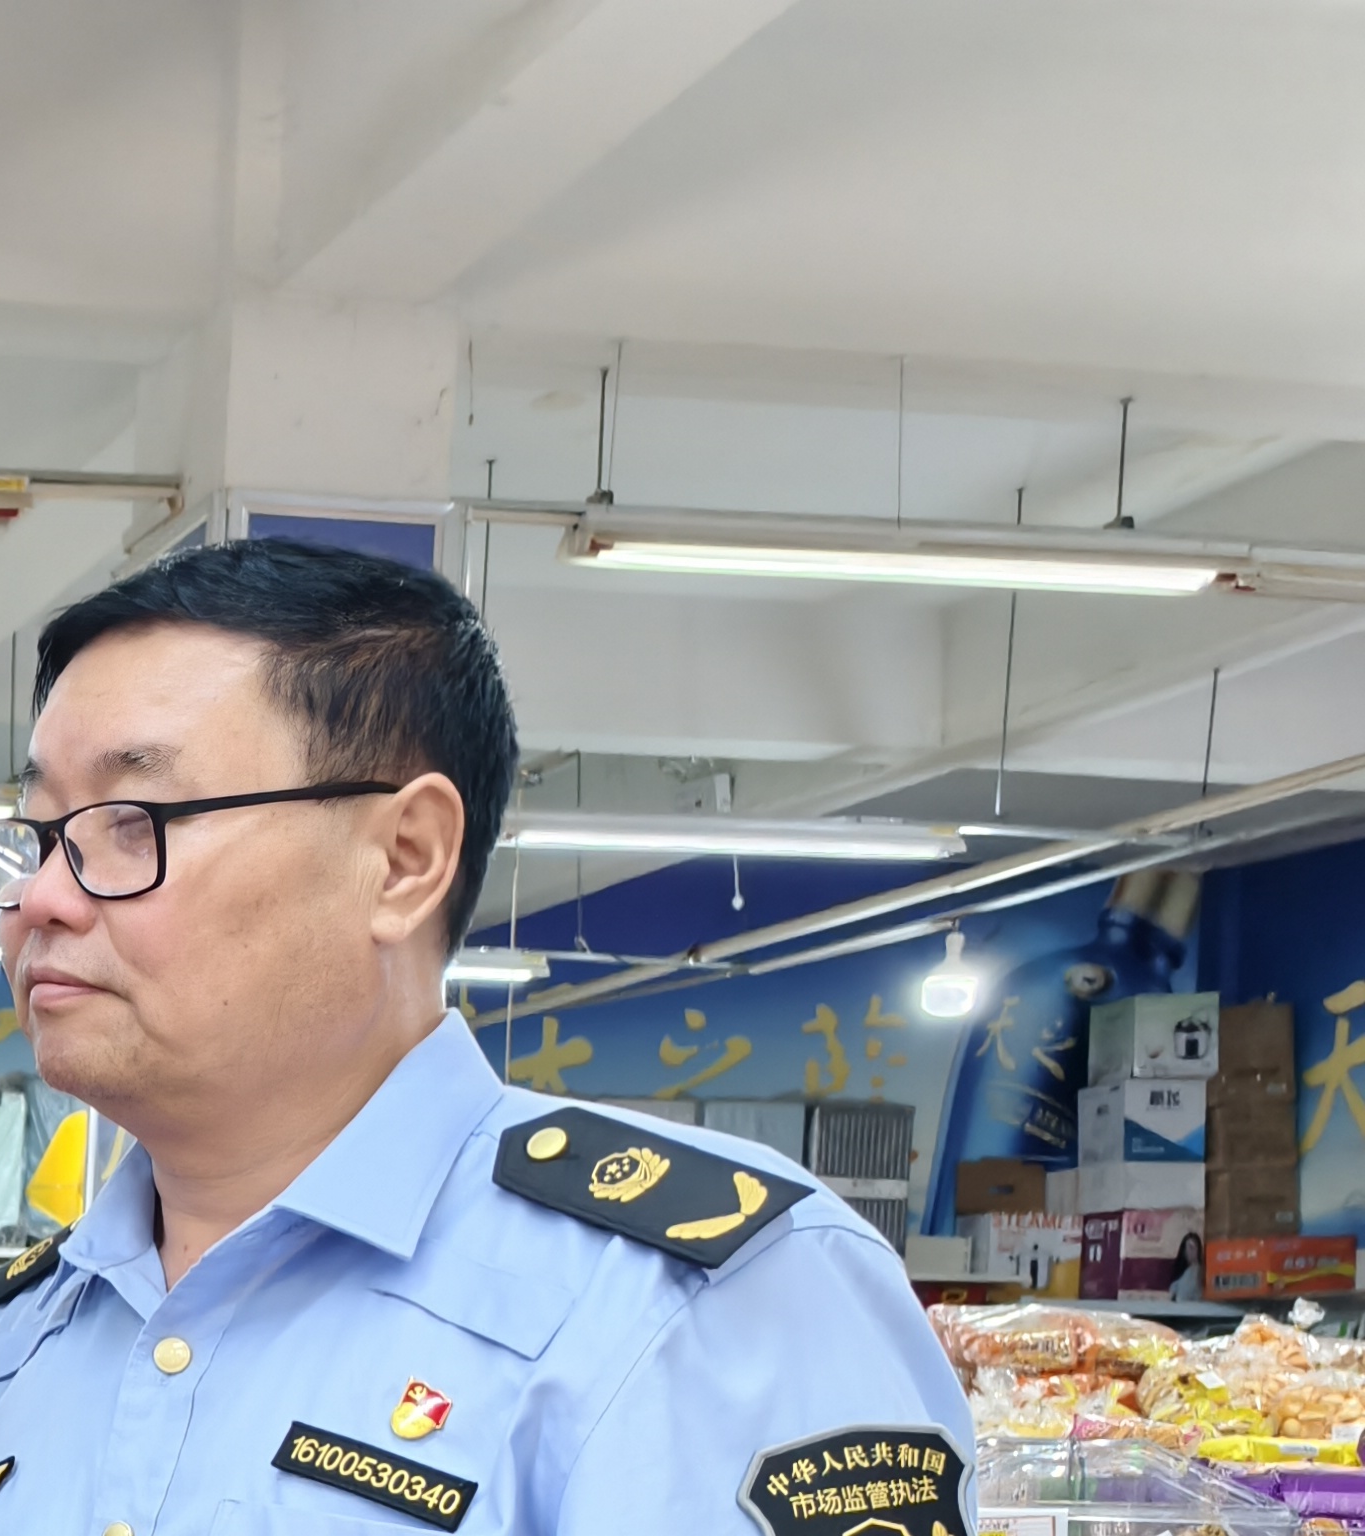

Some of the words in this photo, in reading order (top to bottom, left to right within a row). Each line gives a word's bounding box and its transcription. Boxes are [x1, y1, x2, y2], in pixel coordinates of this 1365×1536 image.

[290, 1435, 461, 1515] 16100530340
[767, 1441, 946, 1497] 中华人民共和国
[789, 1475, 939, 1520] 市场监管执法
